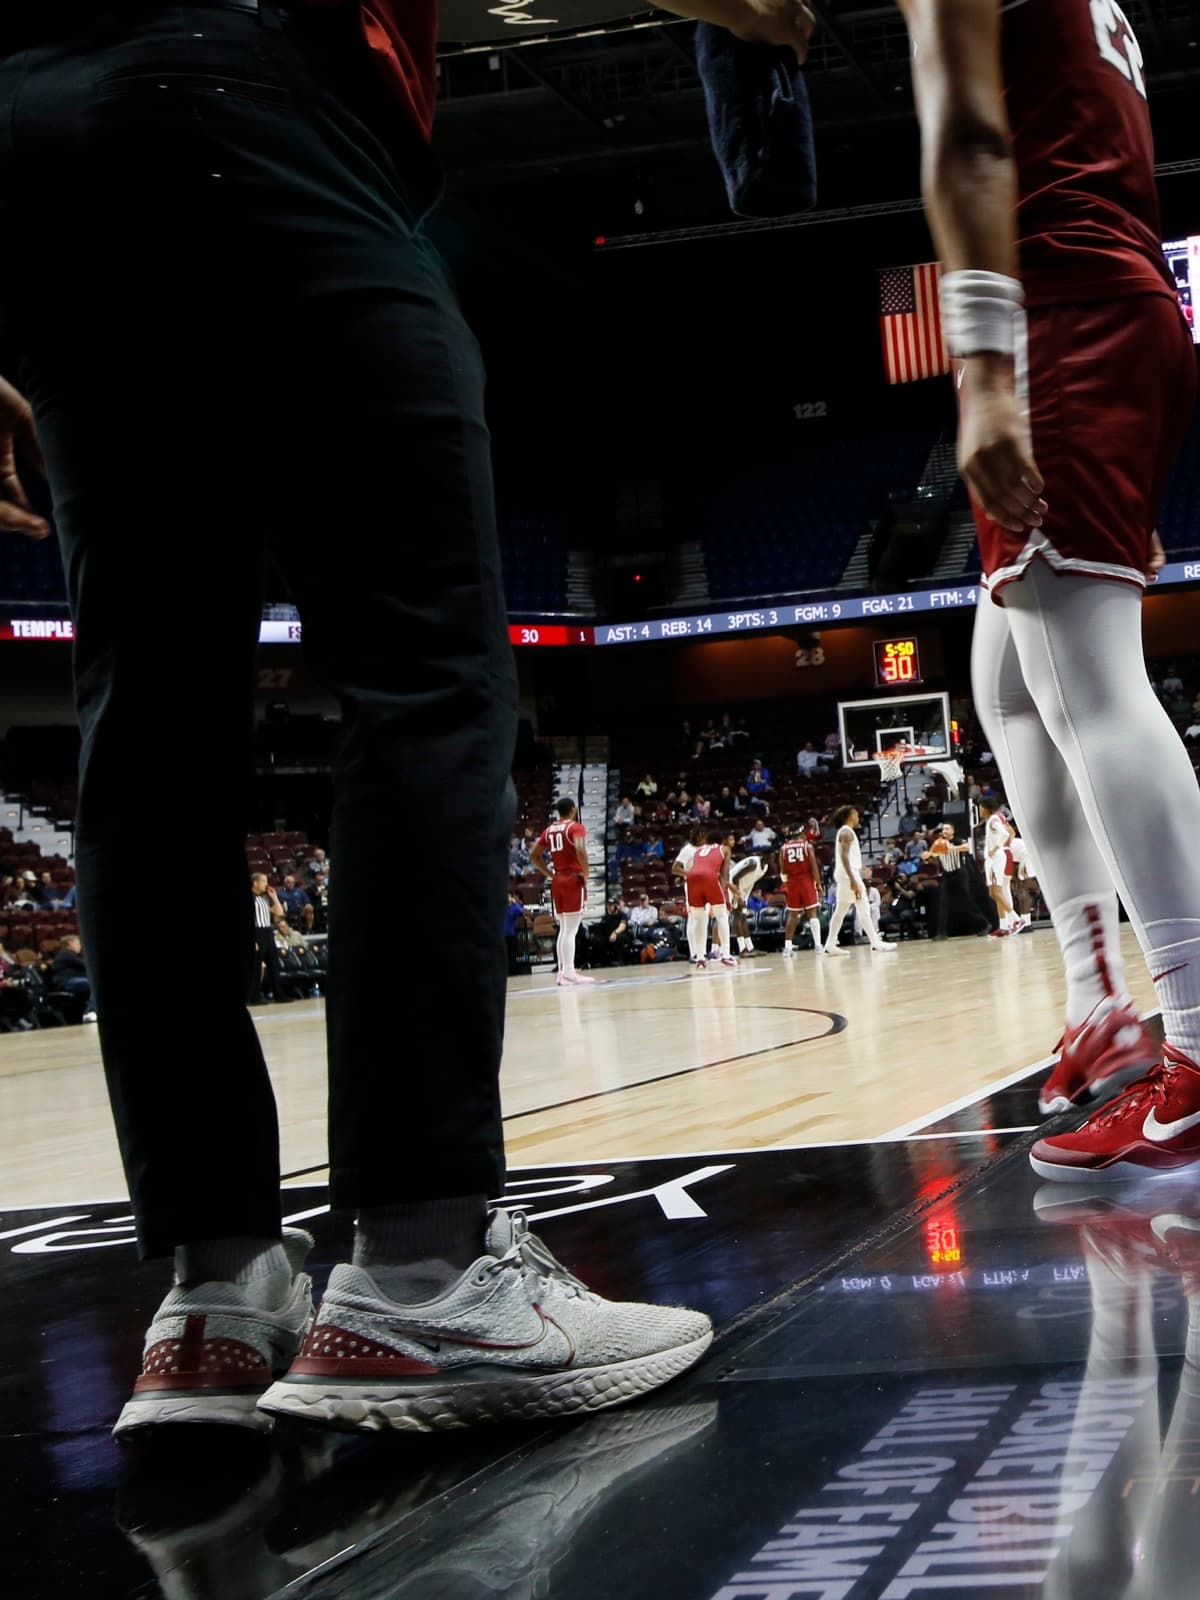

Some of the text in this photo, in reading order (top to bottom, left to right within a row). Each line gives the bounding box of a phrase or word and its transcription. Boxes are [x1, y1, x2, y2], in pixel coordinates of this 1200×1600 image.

[793, 402, 828, 420] 122
[606, 589, 976, 642] AST: 4 REB: 14 3PTS: 3 FGM: 9 FGA: 21 FTM: 4
[11, 620, 73, 637] TEMPLE
[521, 629, 539, 643] 30
[580, 632, 586, 641] 1
[795, 647, 825, 667] 28
[885, 641, 914, 657] 5:50
[258, 668, 293, 689] 27
[883, 656, 912, 681] 30
[548, 833, 564, 853] 10
[787, 847, 805, 863] 24
[708, 1384, 1018, 1600] HALL OF FAME
[878, 1379, 1157, 1600] BASKETBALL
